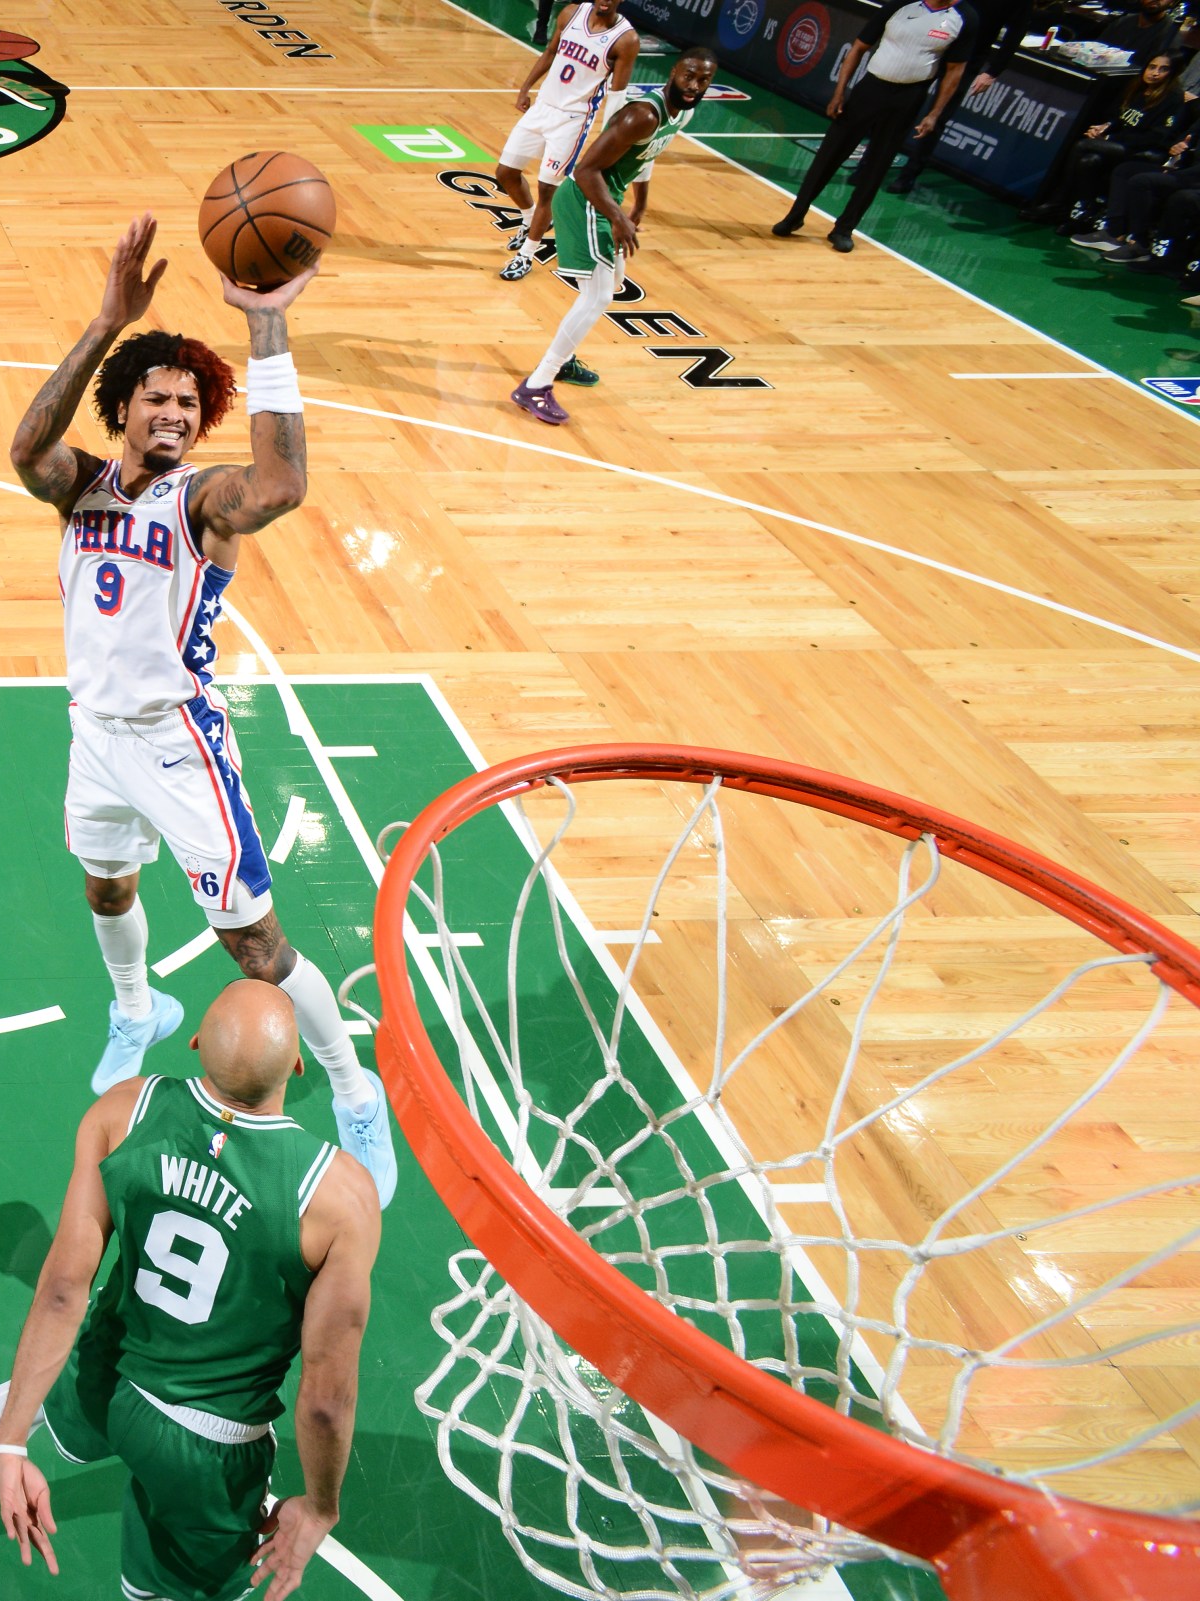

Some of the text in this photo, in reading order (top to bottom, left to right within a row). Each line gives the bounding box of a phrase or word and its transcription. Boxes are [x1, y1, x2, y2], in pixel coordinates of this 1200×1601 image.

[763, 18, 778, 41] VS
[558, 39, 600, 72] PHILA
[560, 64, 576, 84] 0
[1000, 89, 1044, 133] 7PM
[1034, 107, 1067, 141] ET
[383, 128, 466, 159] TD
[547, 158, 561, 171] 76
[73, 509, 174, 571] PHILA
[94, 562, 125, 617] 9
[186, 868, 220, 897] 76
[160, 1154, 252, 1231] WHITE
[134, 1210, 230, 1325] 9
